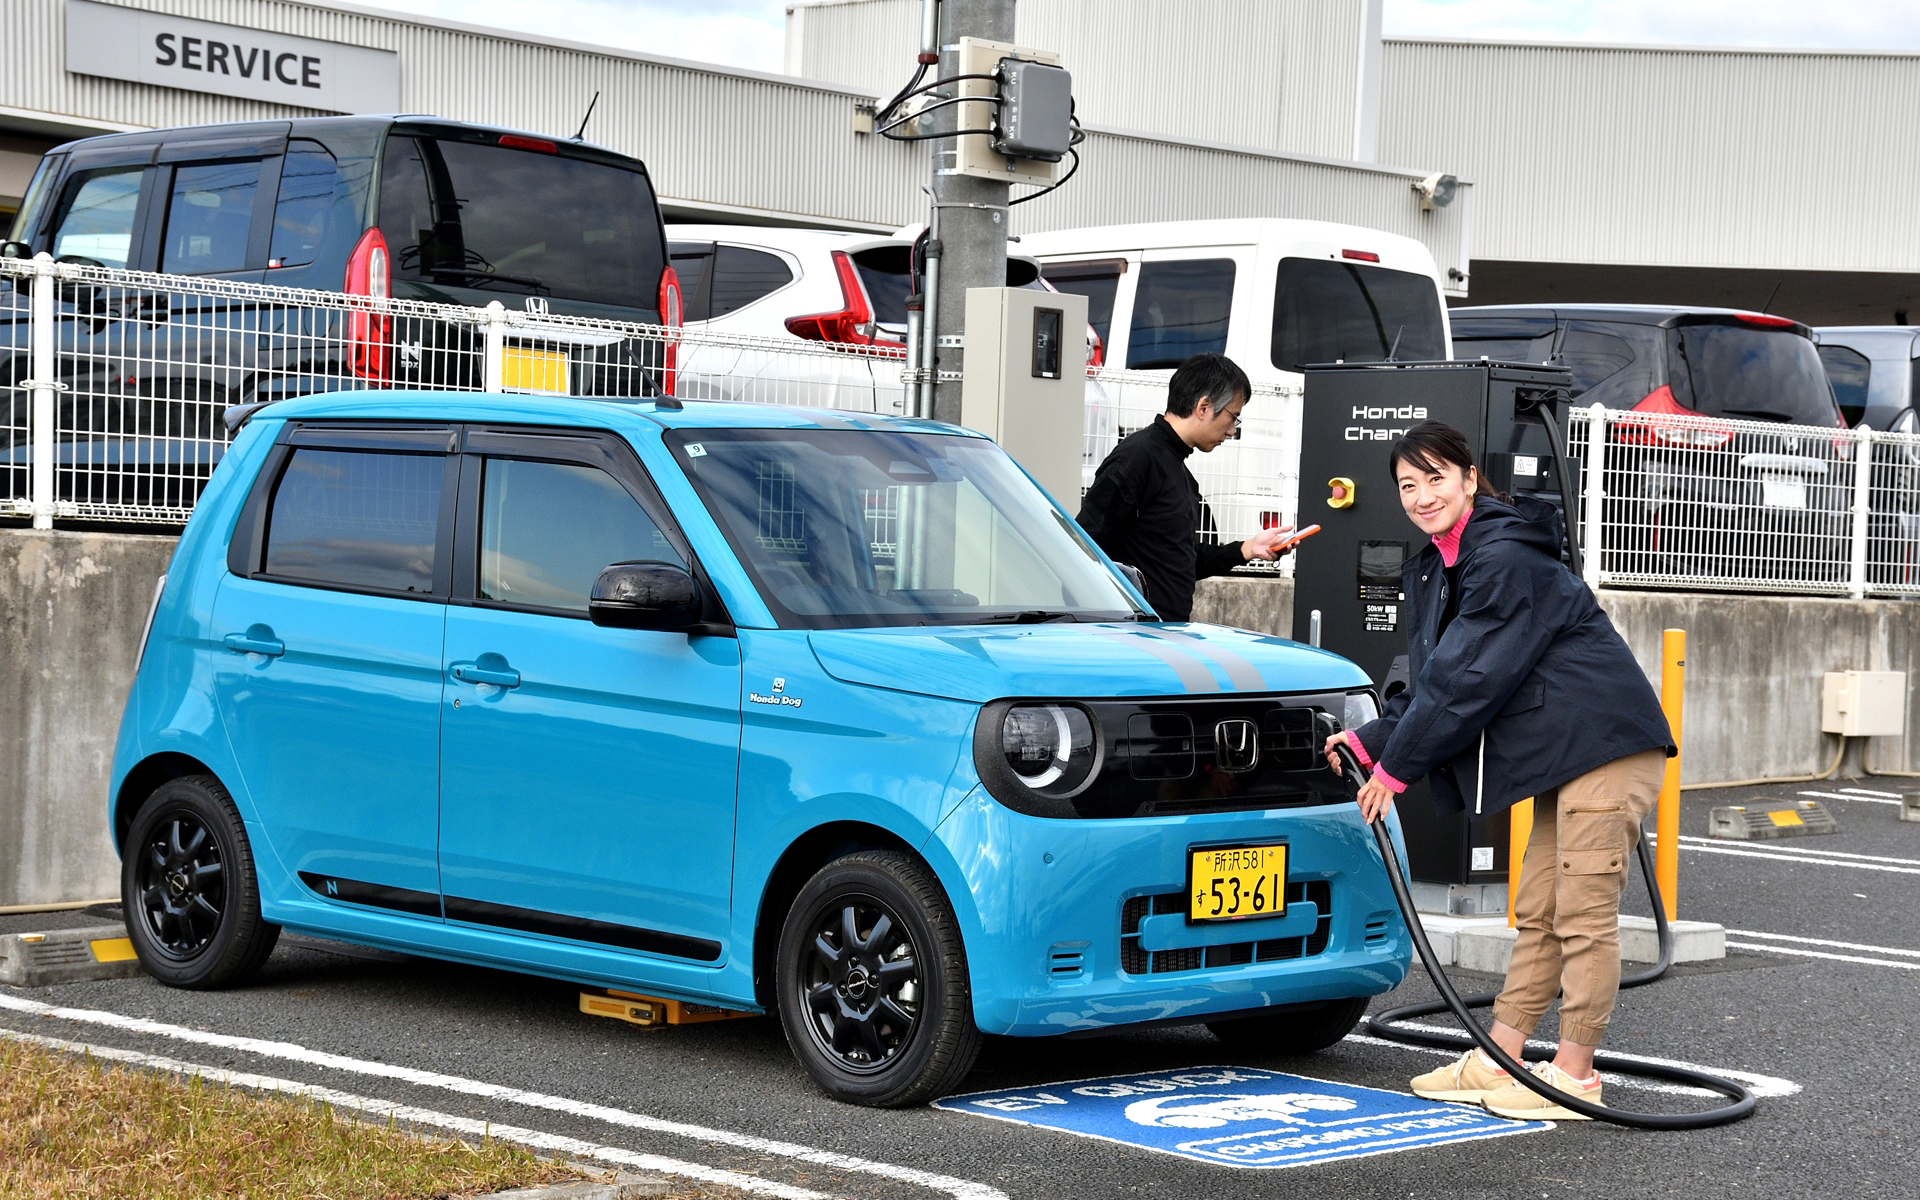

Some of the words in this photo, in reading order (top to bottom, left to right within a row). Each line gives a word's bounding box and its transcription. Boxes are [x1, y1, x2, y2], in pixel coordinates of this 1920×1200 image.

[155, 32, 321, 89] SERVICE
[401, 339, 420, 360] N
[1352, 404, 1428, 419] Honda
[692, 445, 701, 453] 9
[750, 692, 781, 705] Honda
[782, 695, 802, 708] Dog
[326, 880, 338, 895] N
[1210, 873, 1279, 916] 53-61
[969, 1093, 1068, 1111] EV
[1071, 1070, 1271, 1097] QUICK
[1217, 1127, 1394, 1156] CHARGING
[1380, 1114, 1482, 1132] POINT
